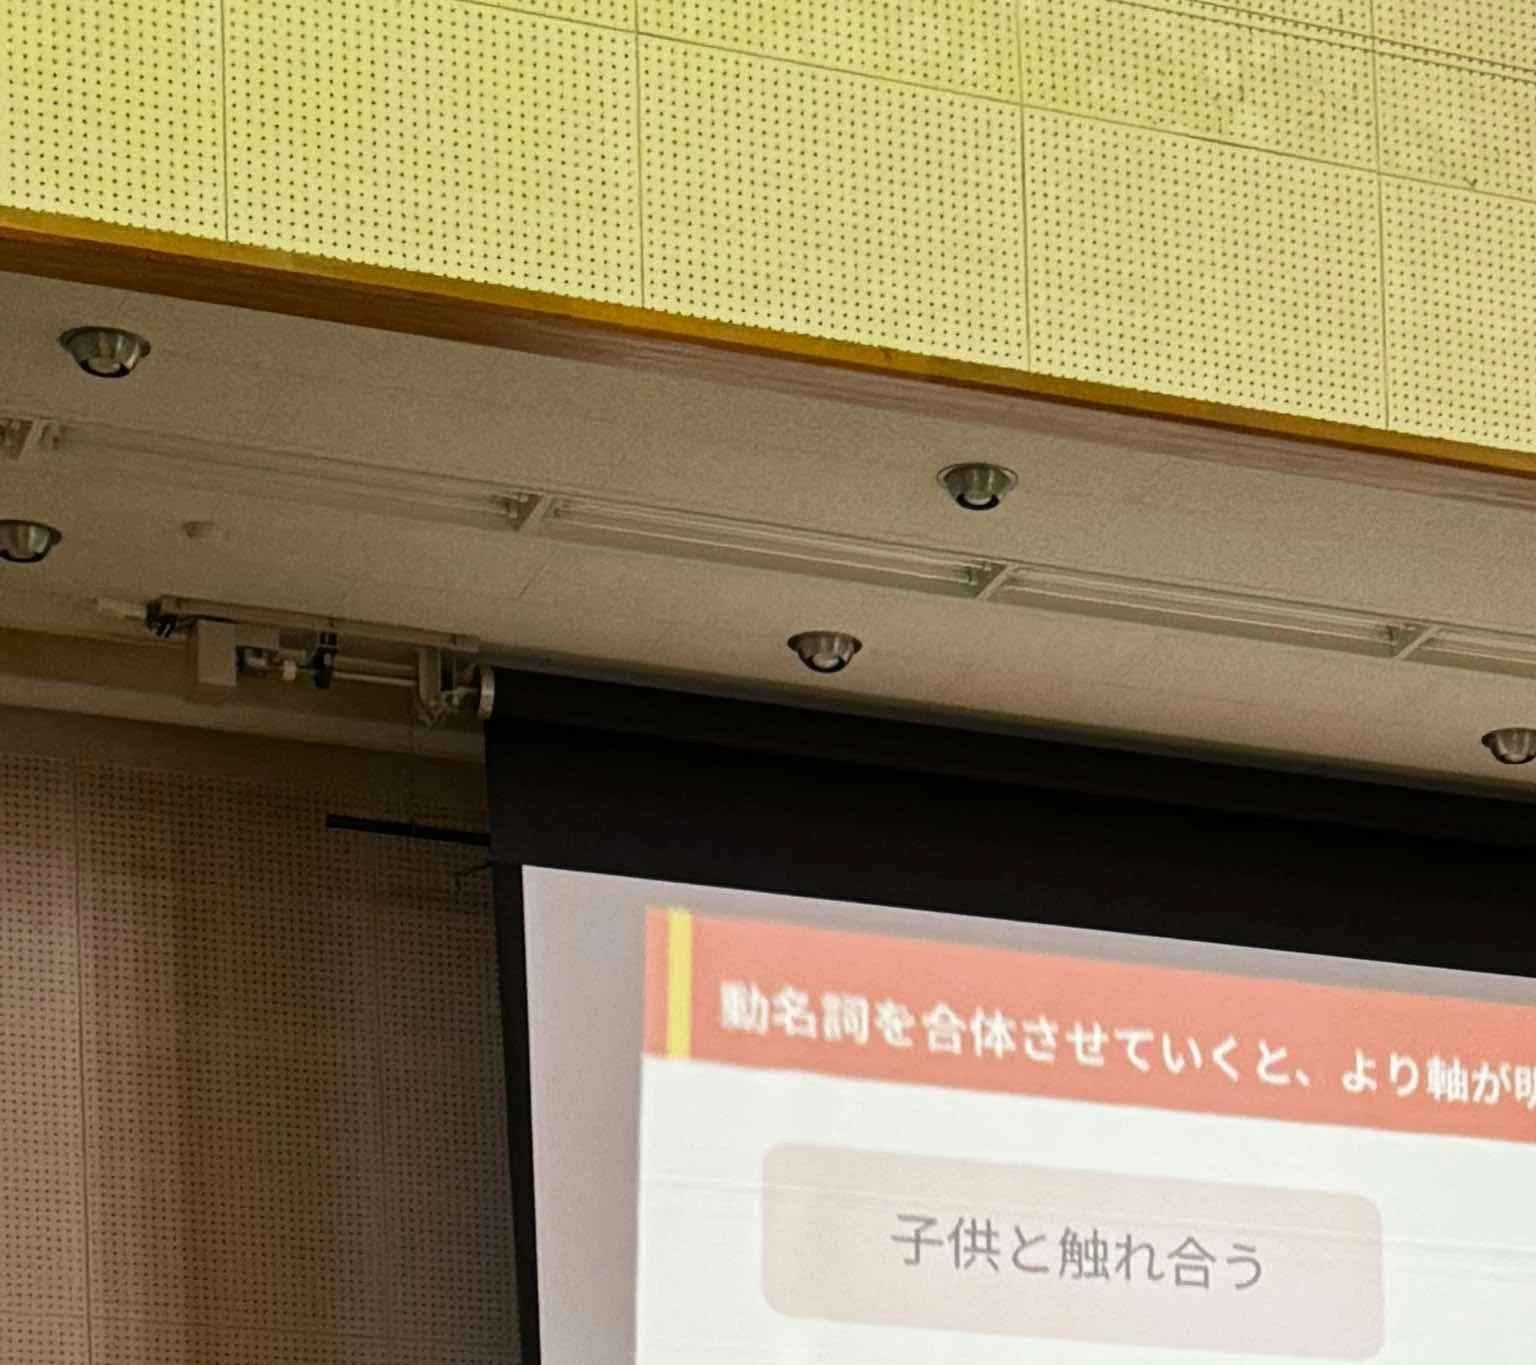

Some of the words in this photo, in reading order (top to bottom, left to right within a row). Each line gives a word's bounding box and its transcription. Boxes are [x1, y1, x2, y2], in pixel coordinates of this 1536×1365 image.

[890, 1213, 1264, 1292] 子供と触れ合う
